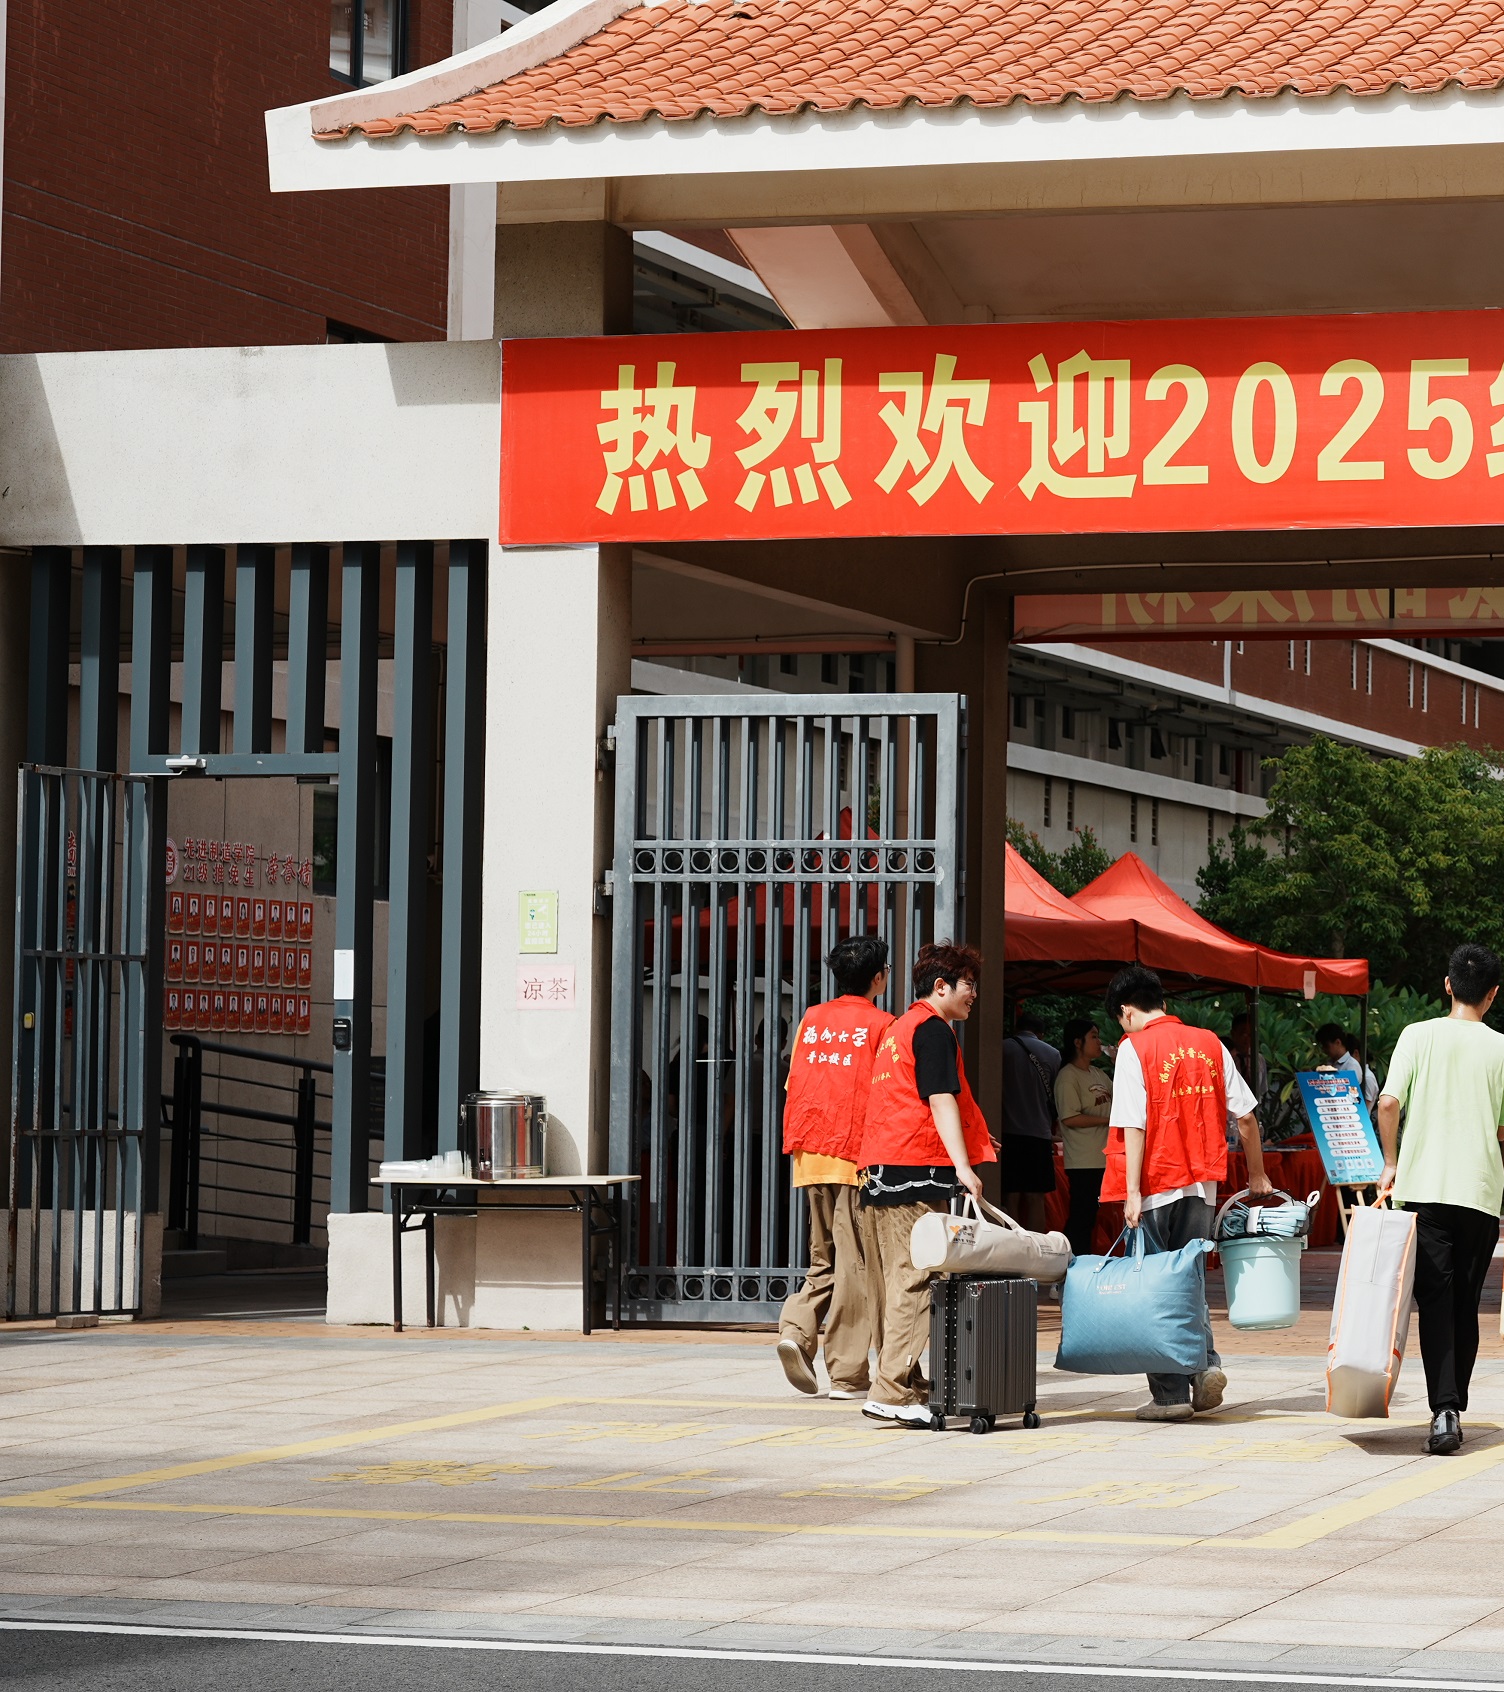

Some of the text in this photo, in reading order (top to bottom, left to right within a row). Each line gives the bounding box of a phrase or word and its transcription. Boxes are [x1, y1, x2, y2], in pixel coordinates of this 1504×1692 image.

[184, 837, 255, 866] 先进制造学院
[183, 862, 255, 887] 21级推免生
[265, 852, 313, 888] 荣誉墙
[523, 977, 568, 1001] 凉茶
[803, 1025, 868, 1047] 福州大学
